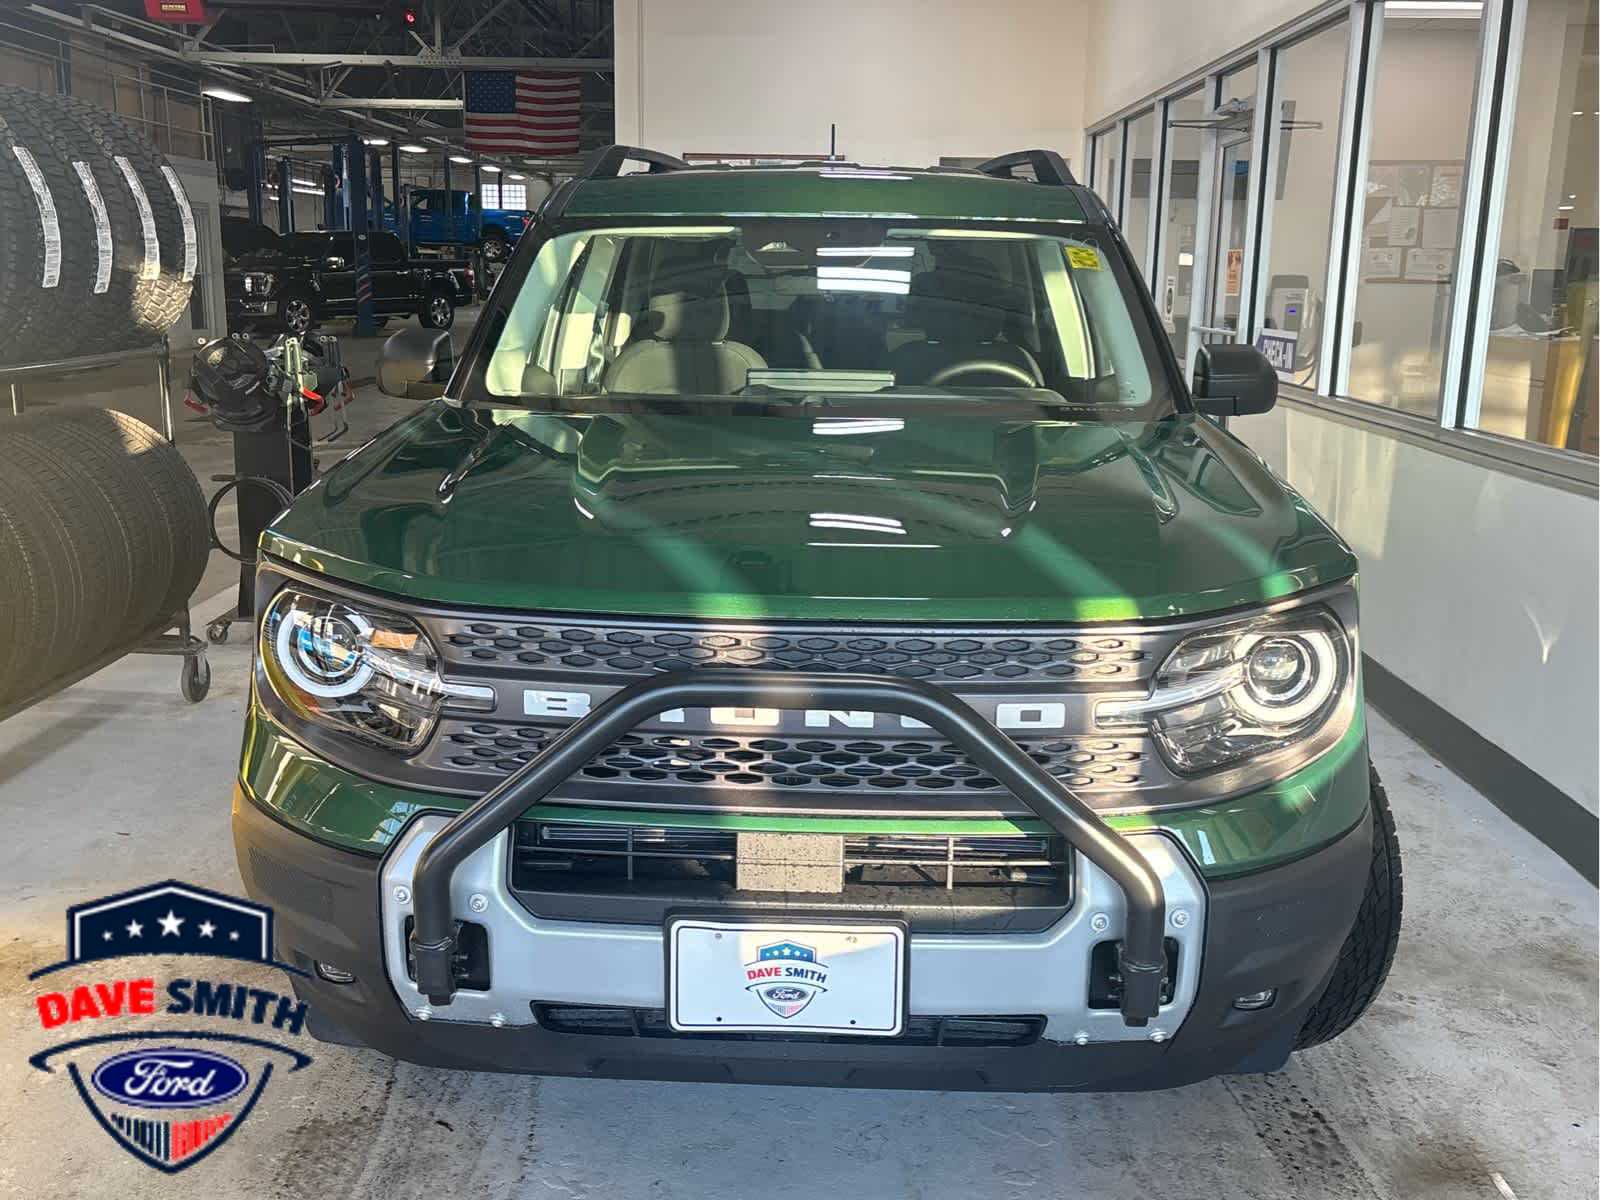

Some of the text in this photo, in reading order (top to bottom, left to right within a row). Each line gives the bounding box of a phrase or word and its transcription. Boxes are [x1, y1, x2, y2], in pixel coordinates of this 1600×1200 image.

[523, 689, 1066, 728] BONO
[747, 967, 827, 983] DAVE SMITH
